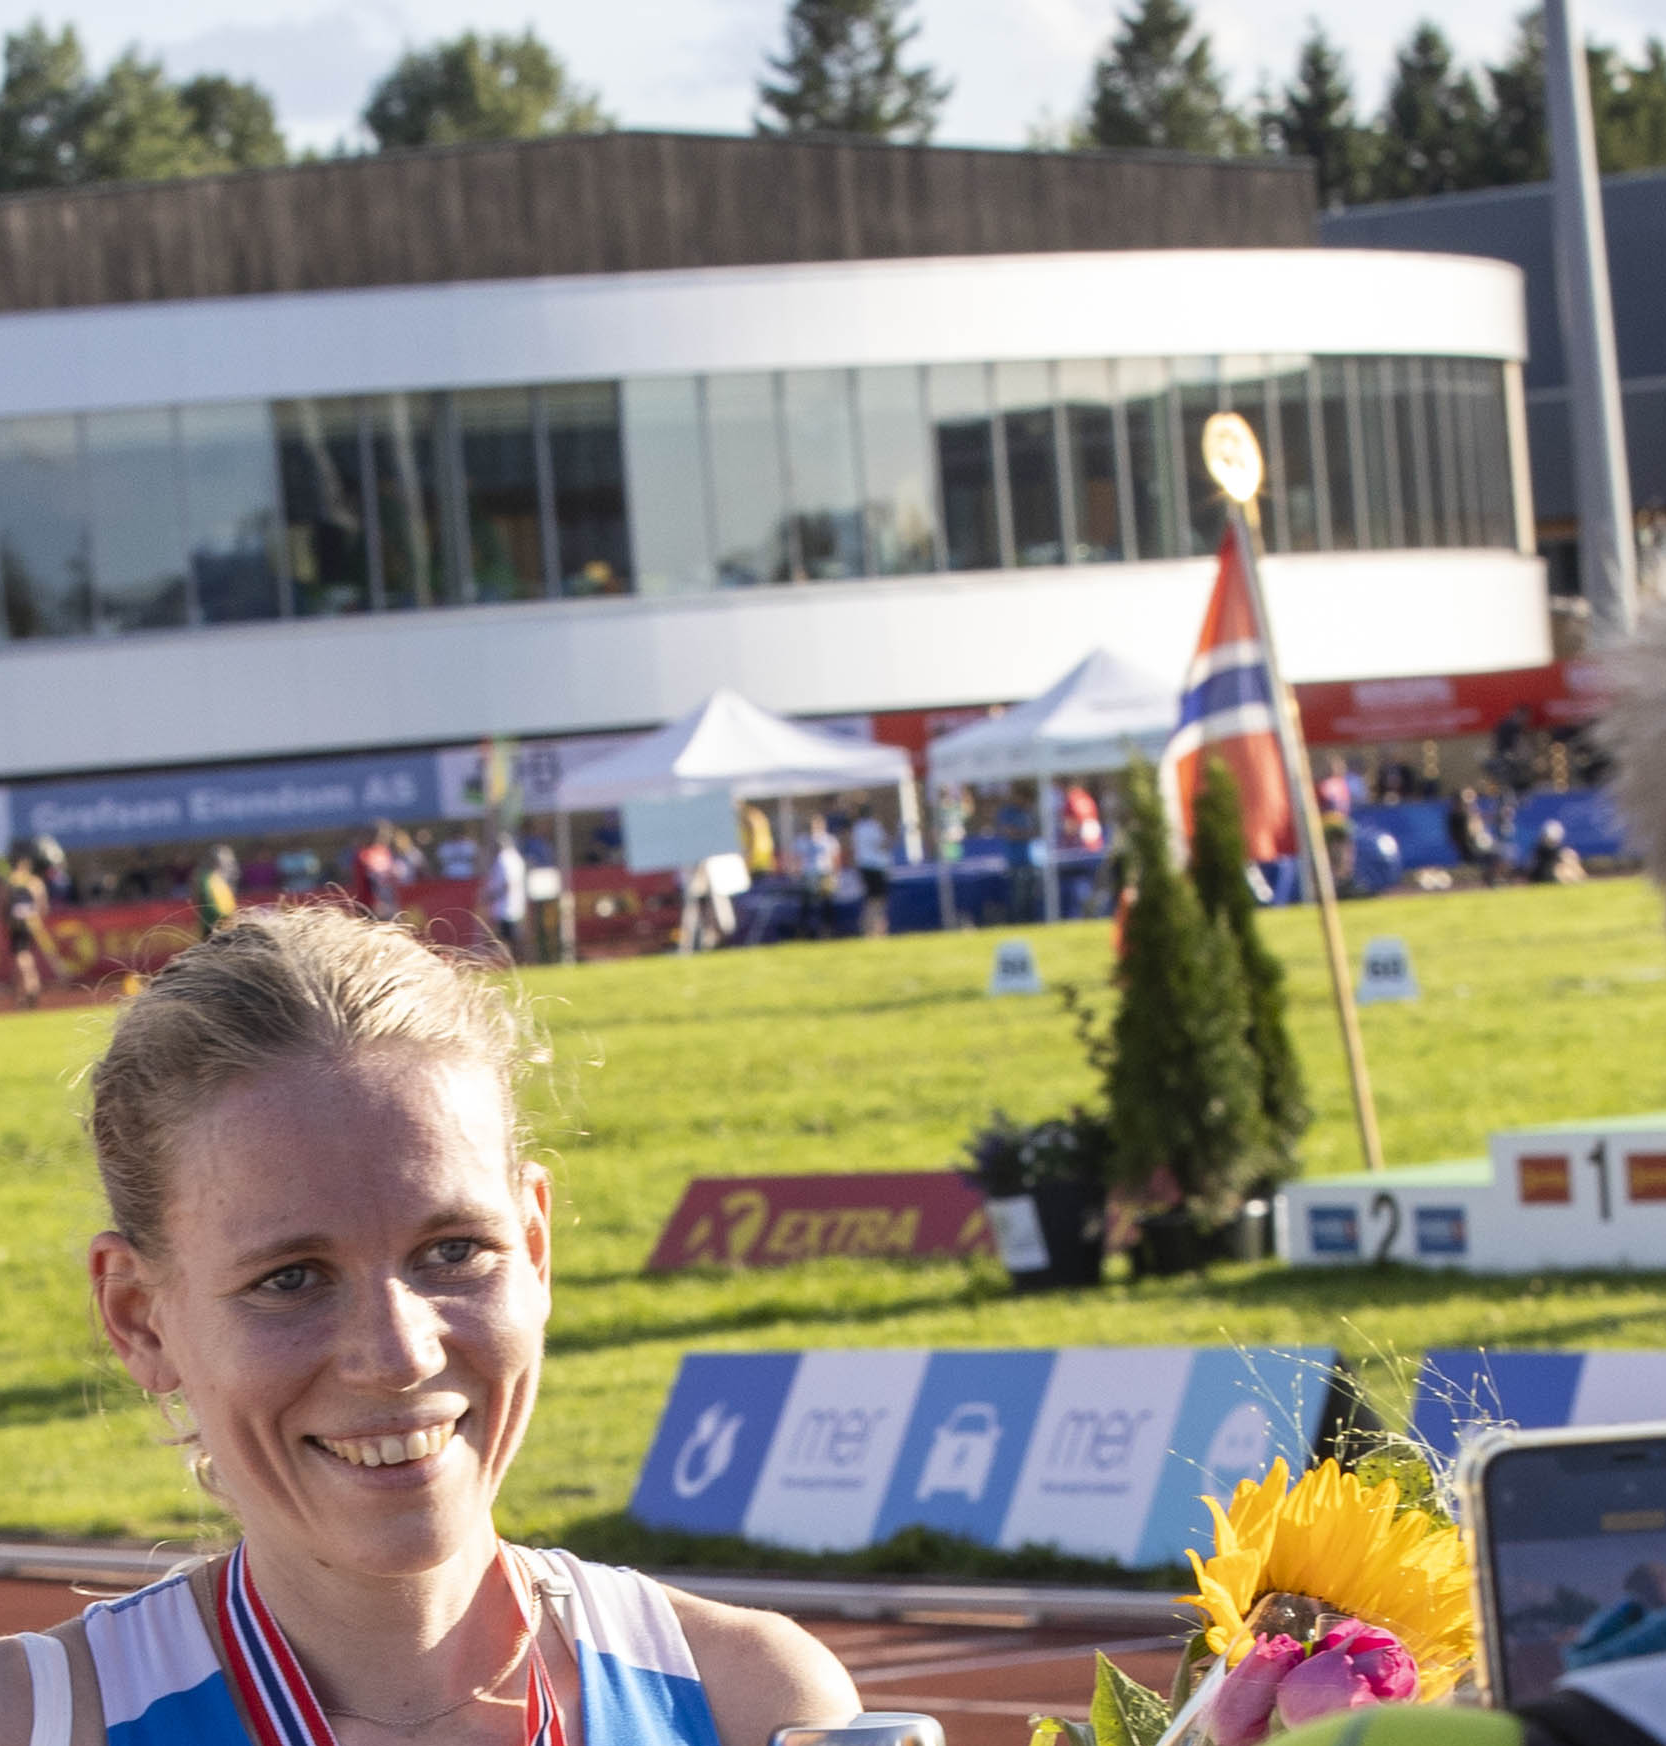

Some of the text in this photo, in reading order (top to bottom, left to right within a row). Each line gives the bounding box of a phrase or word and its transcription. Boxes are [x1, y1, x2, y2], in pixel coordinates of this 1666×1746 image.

[1586, 1137, 1613, 1220] 1
[764, 1206, 925, 1255] EXTRA
[1370, 1190, 1401, 1263] 2
[1048, 1406, 1156, 1471] mer
